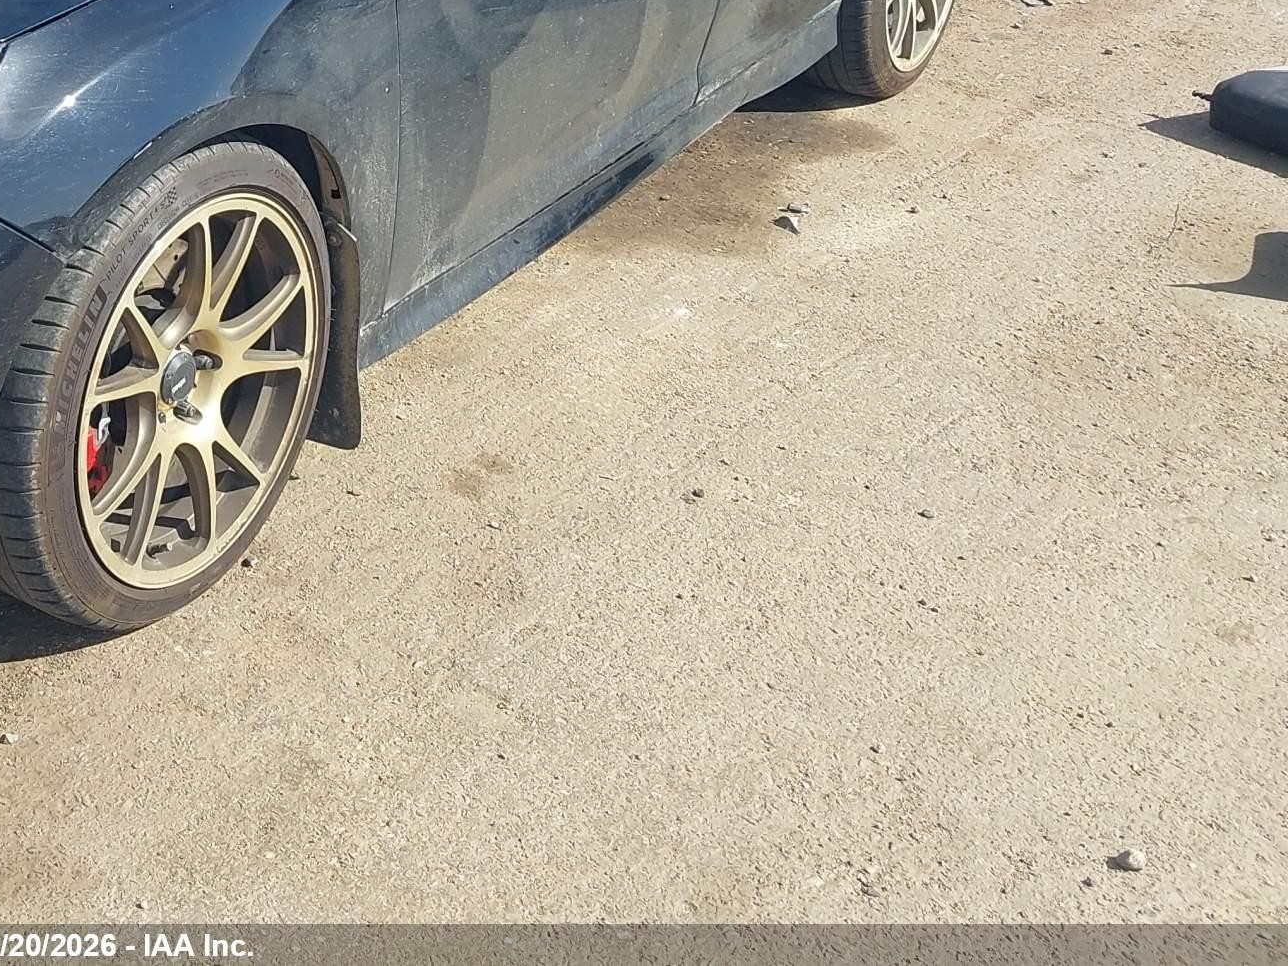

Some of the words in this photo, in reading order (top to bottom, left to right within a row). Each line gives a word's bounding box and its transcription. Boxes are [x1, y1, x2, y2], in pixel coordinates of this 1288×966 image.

[105, 248, 126, 281] PILOT
[128, 212, 153, 247] SPORT
[54, 295, 105, 429] MICHELIN
